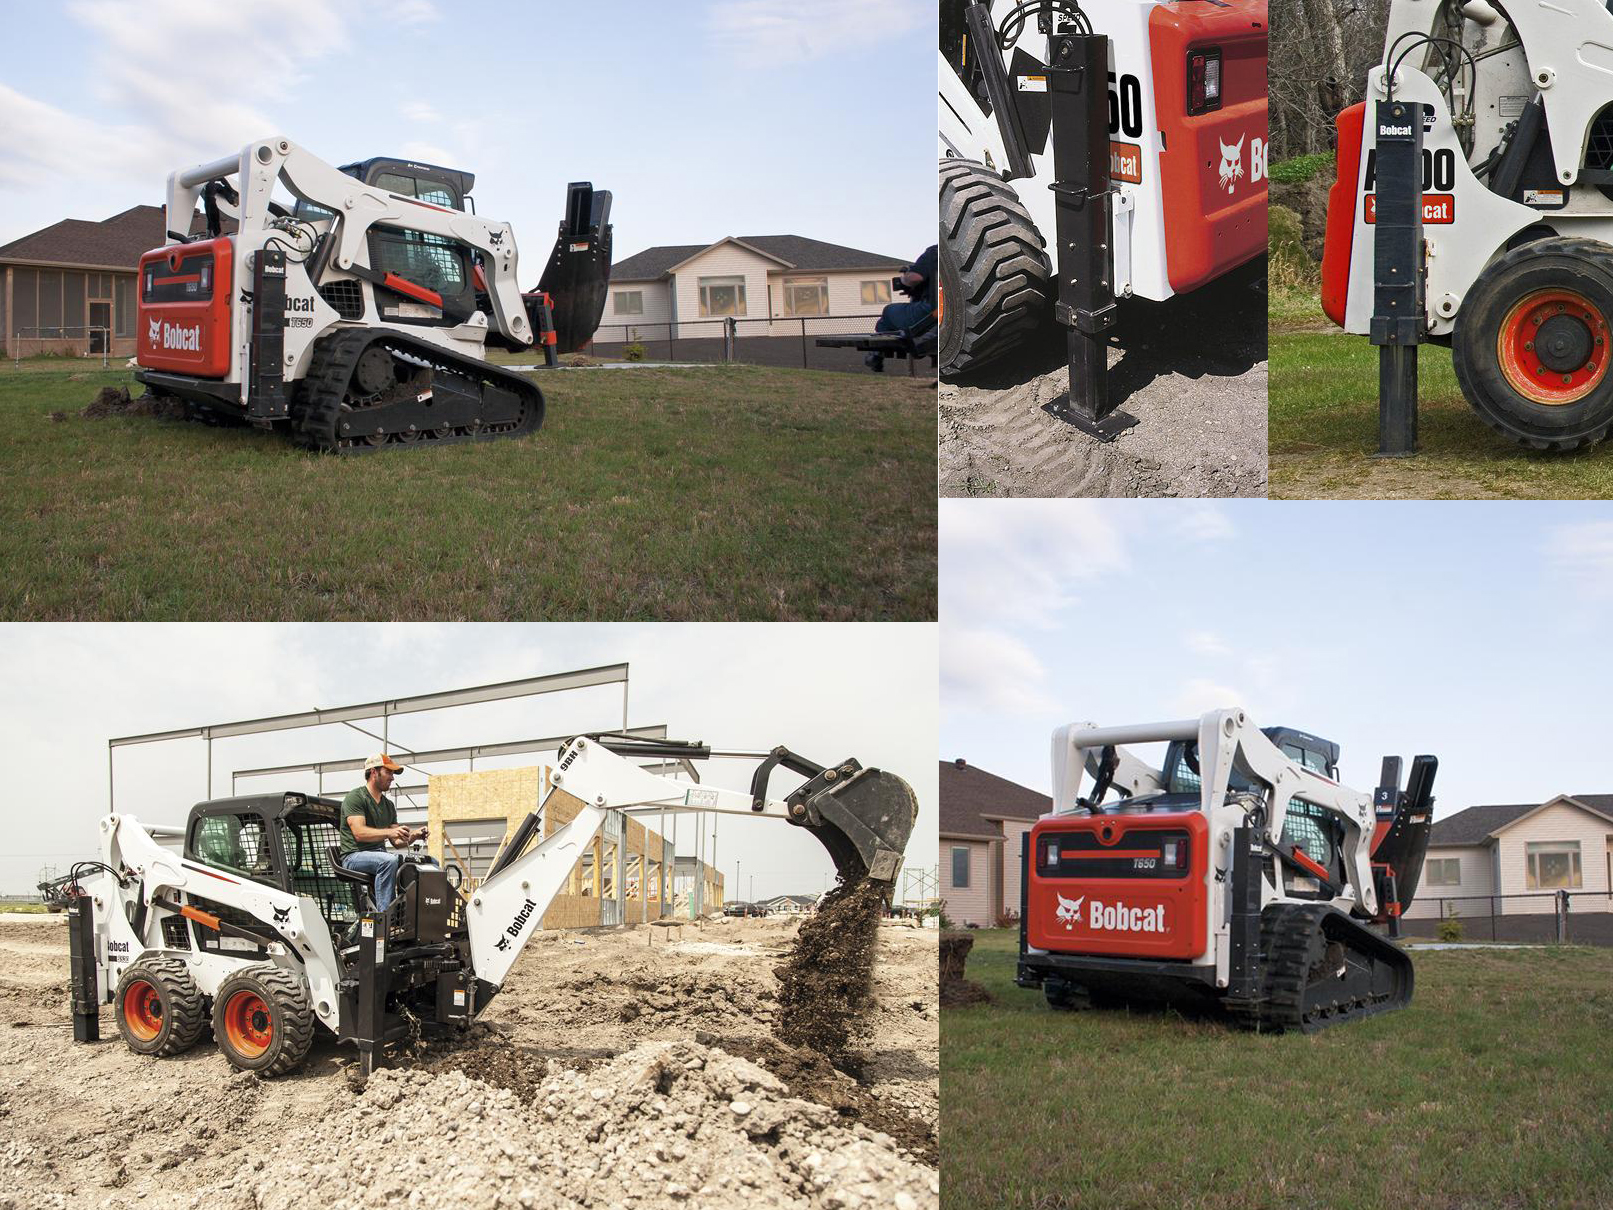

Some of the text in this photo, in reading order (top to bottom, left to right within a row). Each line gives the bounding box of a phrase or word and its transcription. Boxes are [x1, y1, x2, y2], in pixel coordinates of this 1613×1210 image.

[1379, 125, 1413, 136] Bobcat
[1363, 148, 1456, 192] A00
[264, 264, 285, 274] Bobcat
[290, 317, 314, 329] T650
[163, 322, 200, 351] Bobcat
[559, 750, 578, 772] 9BH
[1381, 791, 1389, 801] 3
[1133, 858, 1156, 869] T650
[506, 898, 538, 938] Bobcat
[1089, 900, 1166, 933] Bobcat
